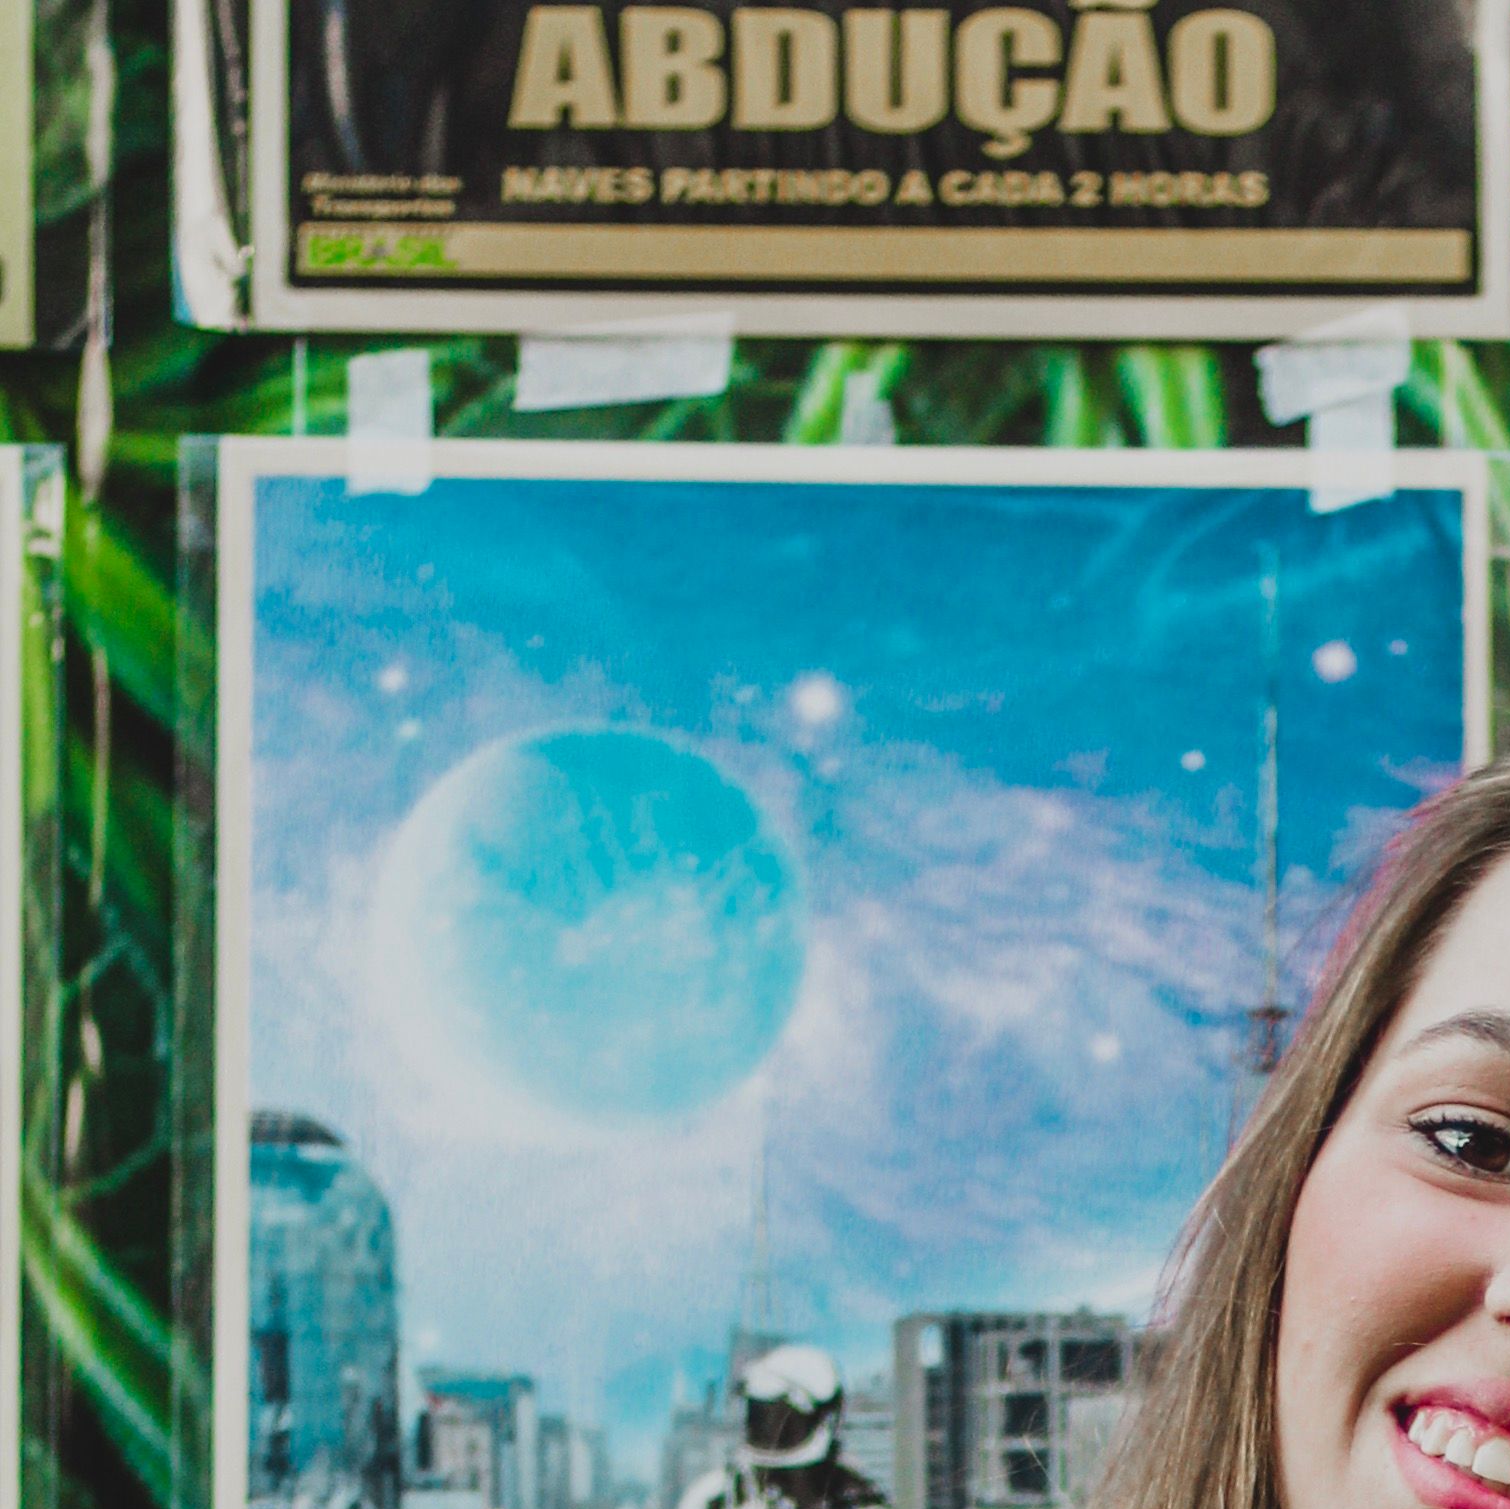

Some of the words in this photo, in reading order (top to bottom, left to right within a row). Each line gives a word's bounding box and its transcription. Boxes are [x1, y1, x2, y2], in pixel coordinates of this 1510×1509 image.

[507, 0, 1278, 160] ABDUÇÃO
[501, 165, 654, 205] NAVES
[659, 167, 890, 206] PARTINDO
[895, 168, 933, 206] A
[937, 168, 1065, 207] CADA
[1069, 170, 1104, 206] 2
[1107, 170, 1270, 208] HORAS
